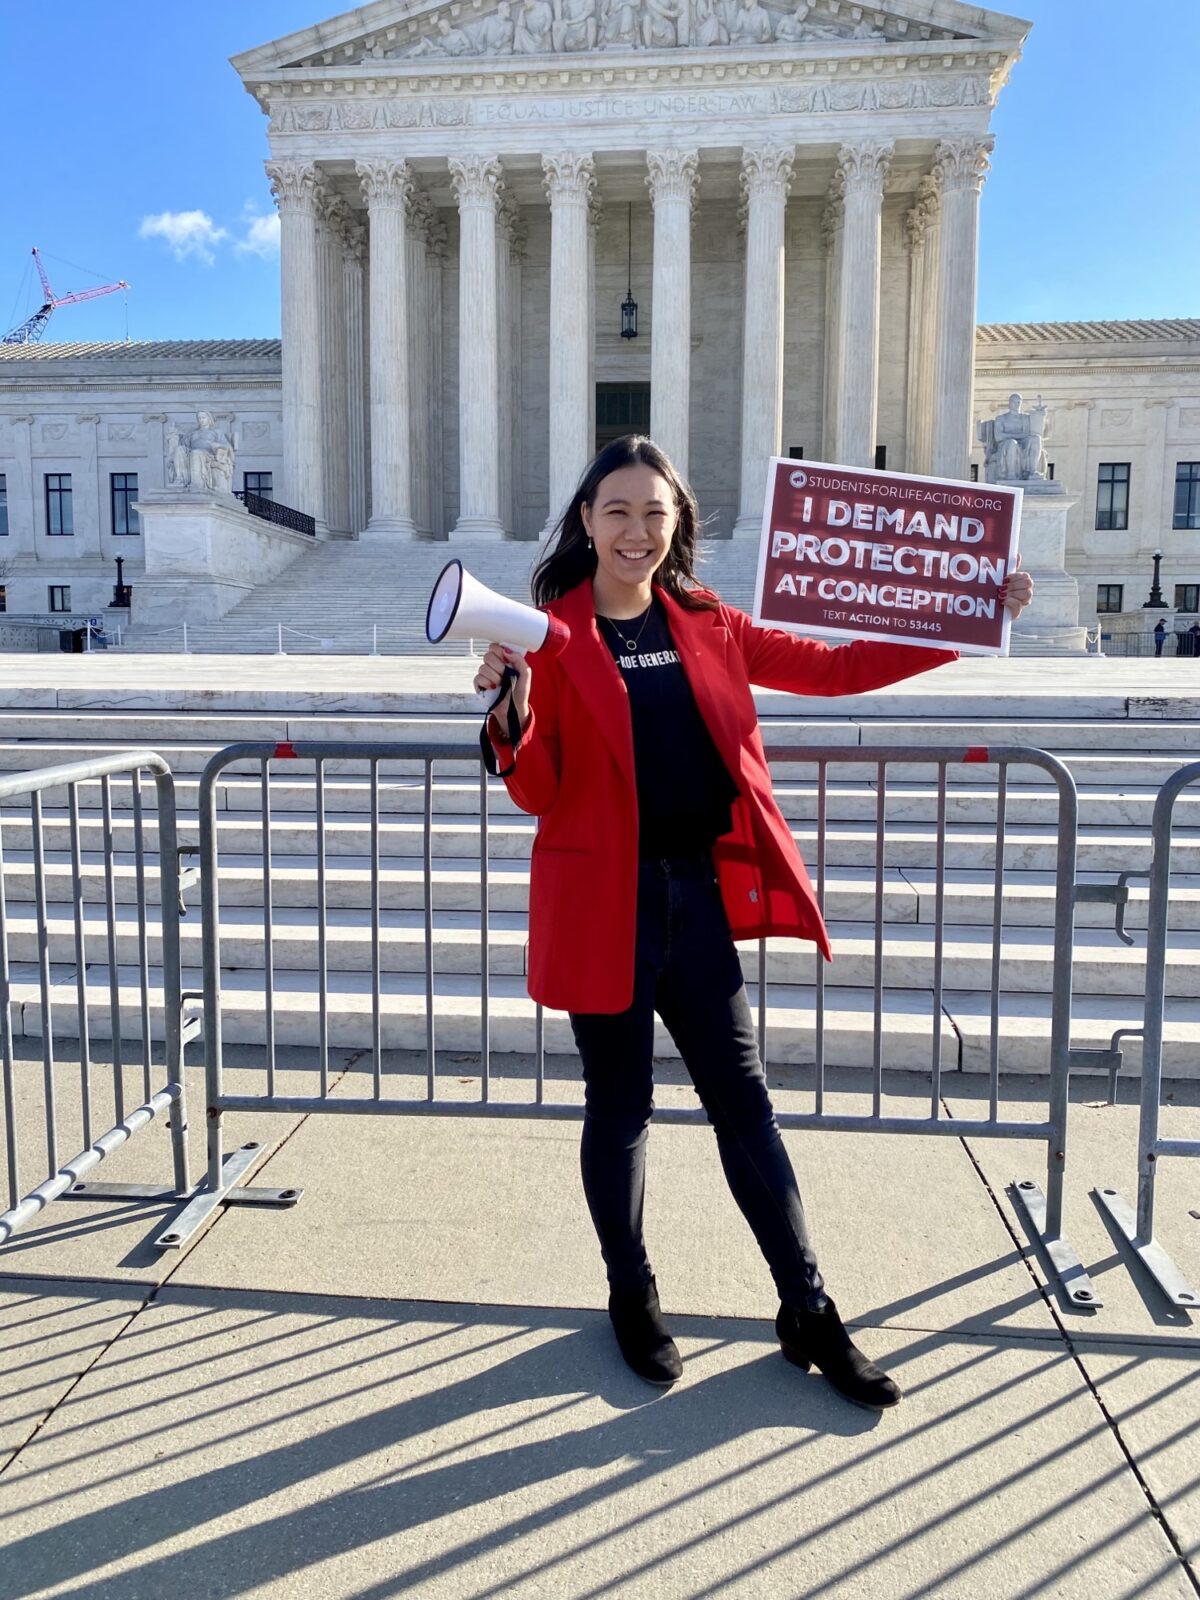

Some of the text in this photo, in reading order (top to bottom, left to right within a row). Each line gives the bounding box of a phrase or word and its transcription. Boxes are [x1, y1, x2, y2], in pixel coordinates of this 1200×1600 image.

[486, 94, 757, 121] EQUAL JUSTICE UNDER LAW
[809, 476, 1002, 511] STUDENTSFORLIFEACTION.ORG
[802, 496, 985, 543] I DEMAND
[771, 531, 1006, 586] PROTECTION
[775, 574, 996, 619] AT CONCEPTION
[823, 609, 942, 632] TEXT ACTION TO 53445
